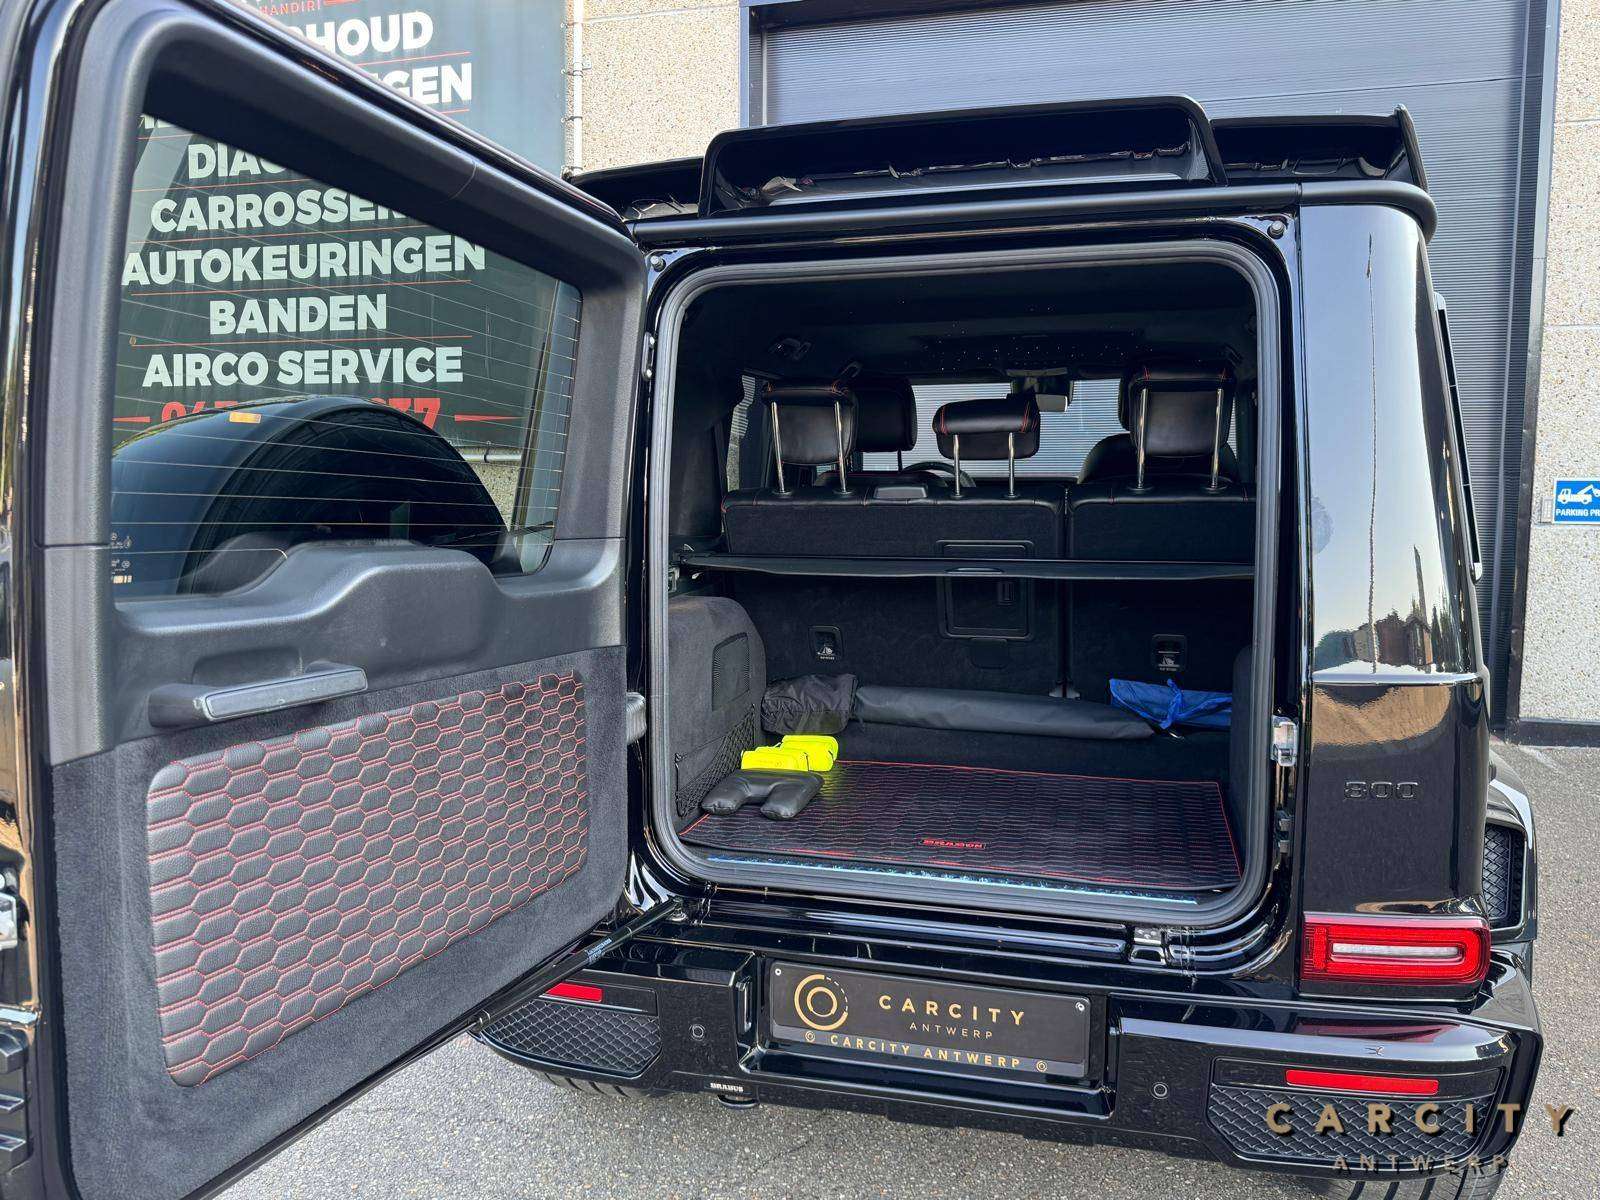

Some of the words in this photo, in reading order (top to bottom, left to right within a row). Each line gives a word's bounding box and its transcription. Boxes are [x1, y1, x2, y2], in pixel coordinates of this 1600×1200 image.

[120, 234, 486, 286] AUTOKEURINGEN
[209, 293, 387, 335] BANDEN
[141, 351, 269, 388] AIRCO
[276, 346, 464, 385] SERVICE
[1555, 508, 1589, 516] PARKING
[878, 994, 1025, 1026] CARCITY
[909, 1021, 994, 1040] ANTWERP
[830, 1034, 911, 1056] CARCITY
[923, 1047, 1021, 1069] ANTWERP
